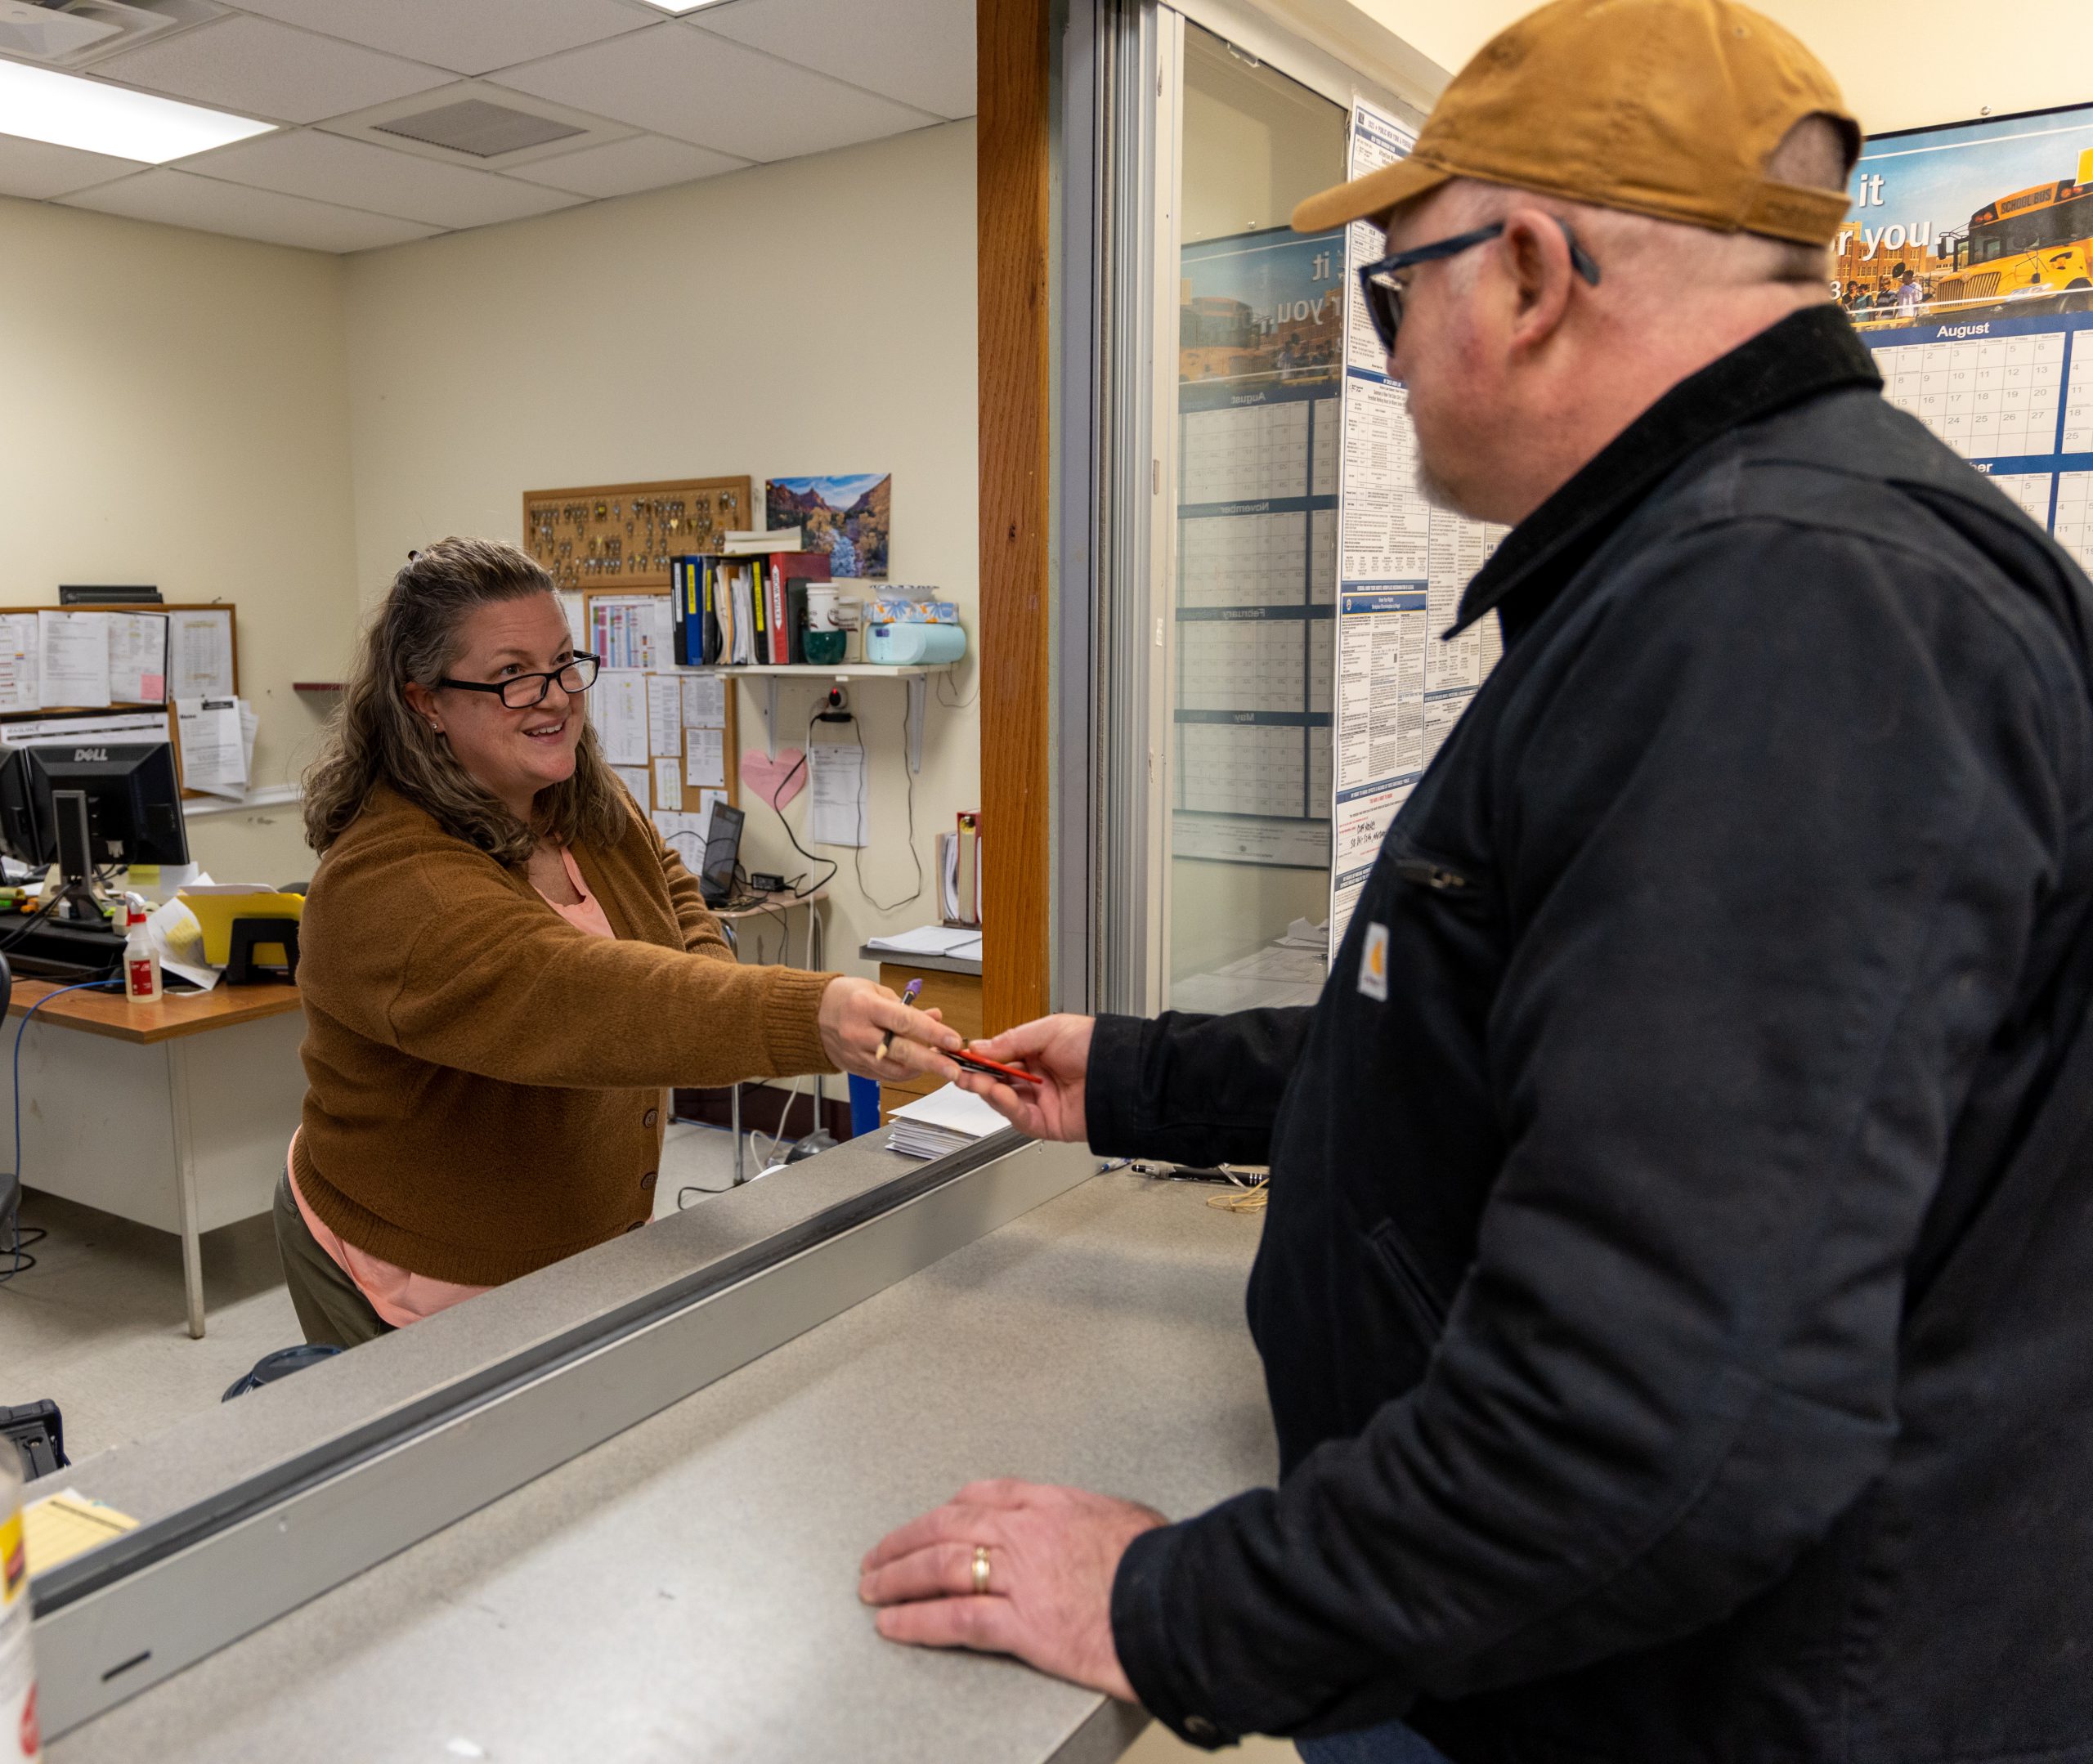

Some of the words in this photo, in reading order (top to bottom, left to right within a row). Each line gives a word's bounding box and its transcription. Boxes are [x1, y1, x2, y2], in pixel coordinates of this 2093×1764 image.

[1859, 174, 1885, 208] it
[2001, 195, 2028, 213] SCHOOL
[2034, 188, 2051, 204] BUS
[1862, 222, 1941, 262] you.
[1936, 322, 1990, 338] August
[1953, 372, 1965, 380] 10
[2034, 388, 2047, 396] 20
[74, 749, 108, 762] DELL
